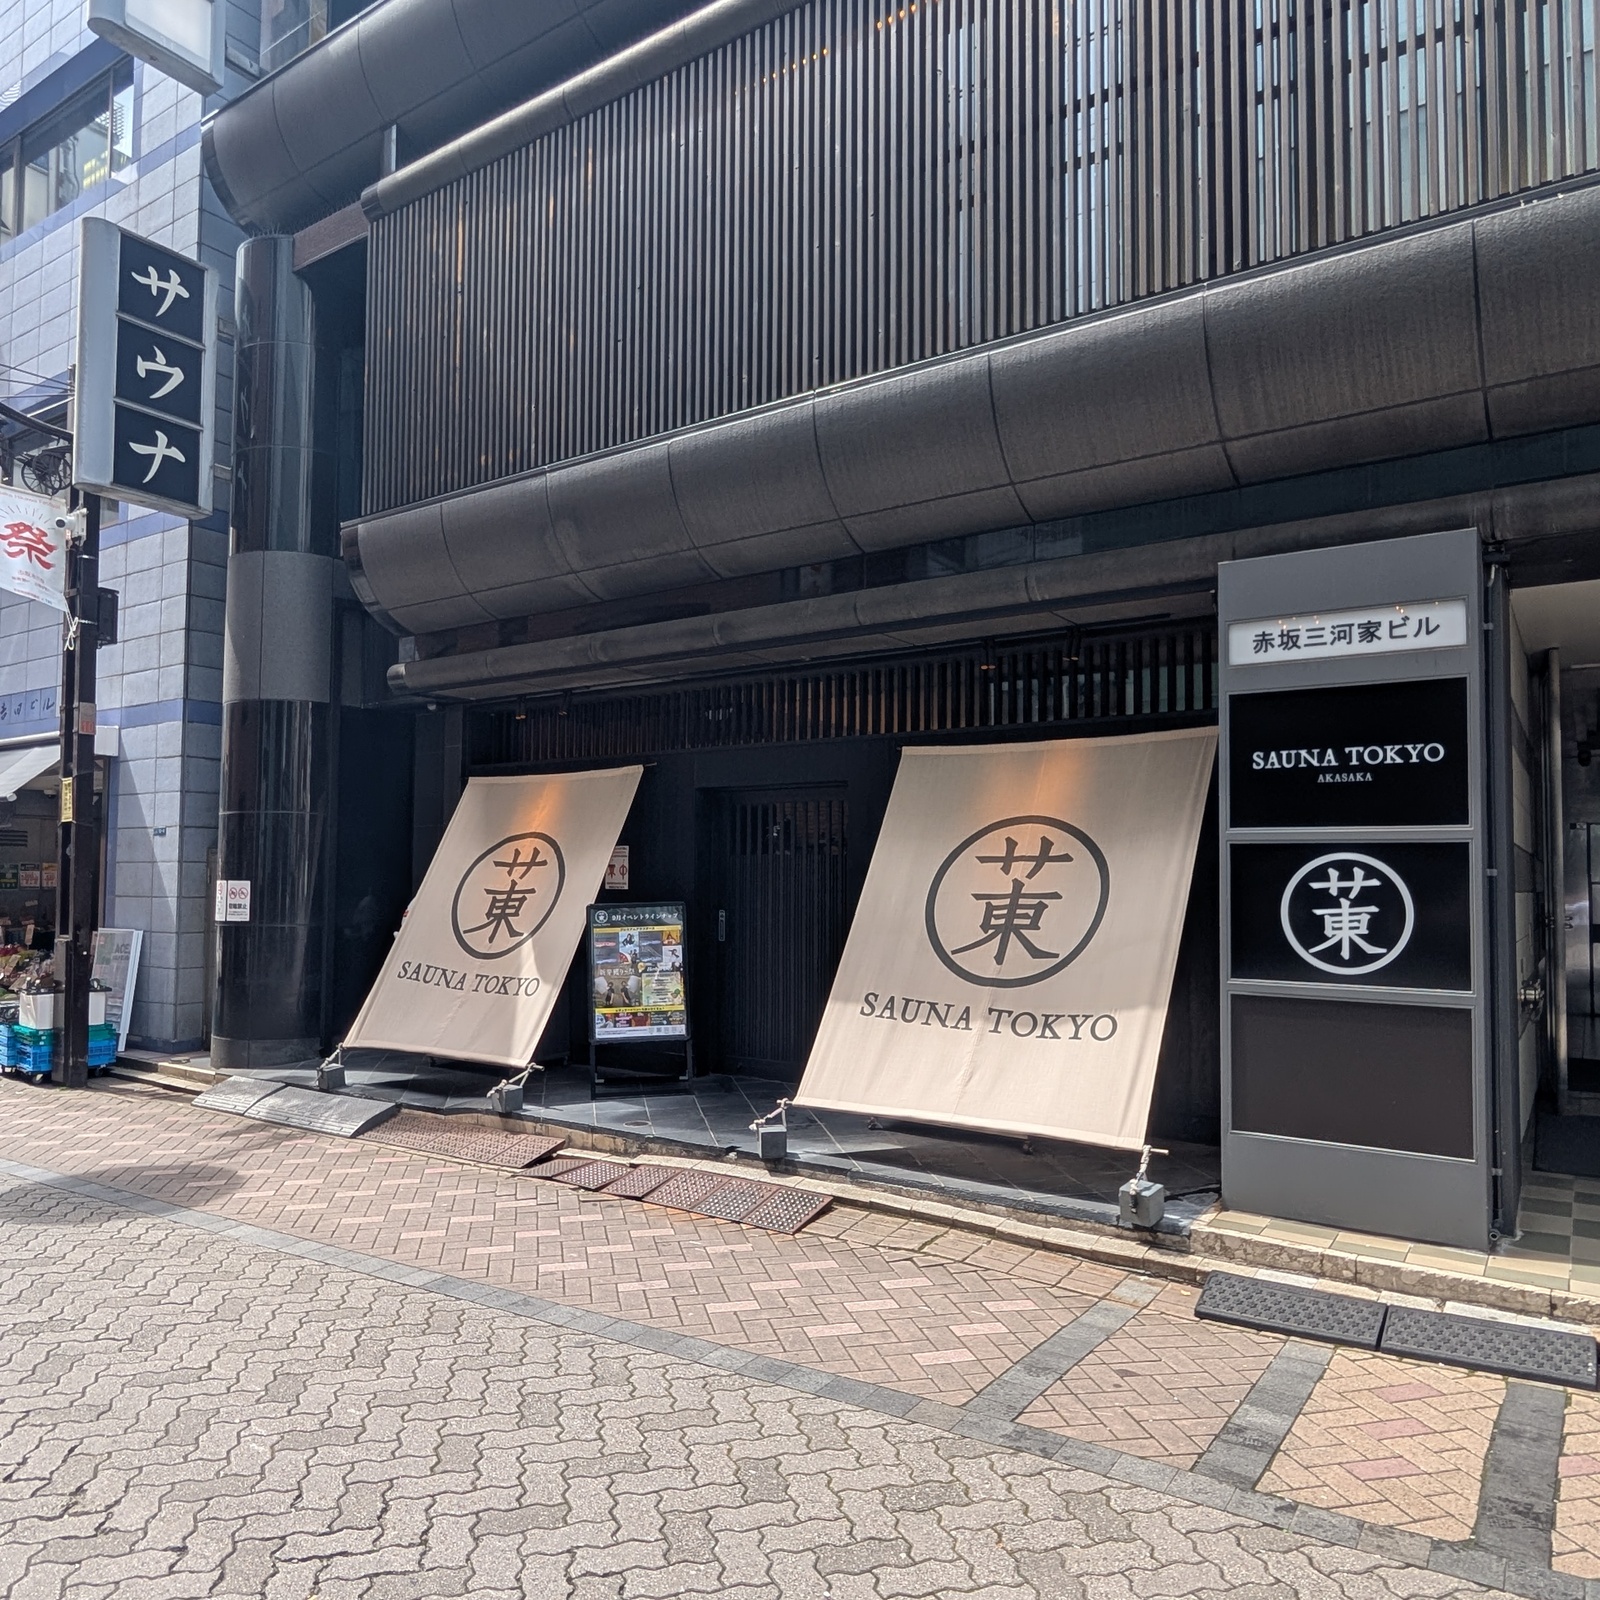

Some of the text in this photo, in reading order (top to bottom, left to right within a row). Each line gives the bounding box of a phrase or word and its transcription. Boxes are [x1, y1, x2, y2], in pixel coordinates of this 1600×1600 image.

[131, 264, 190, 484] サウナ
[0, 521, 58, 570] 祭
[1252, 617, 1441, 655] 赤坂三河家ビル
[1252, 742, 1445, 770] SAUNA TOKYO
[1317, 772, 1373, 783] AKASAKA
[397, 960, 540, 997] SAUNA TOKYO
[860, 992, 1118, 1041] SAUNA TOKYO
